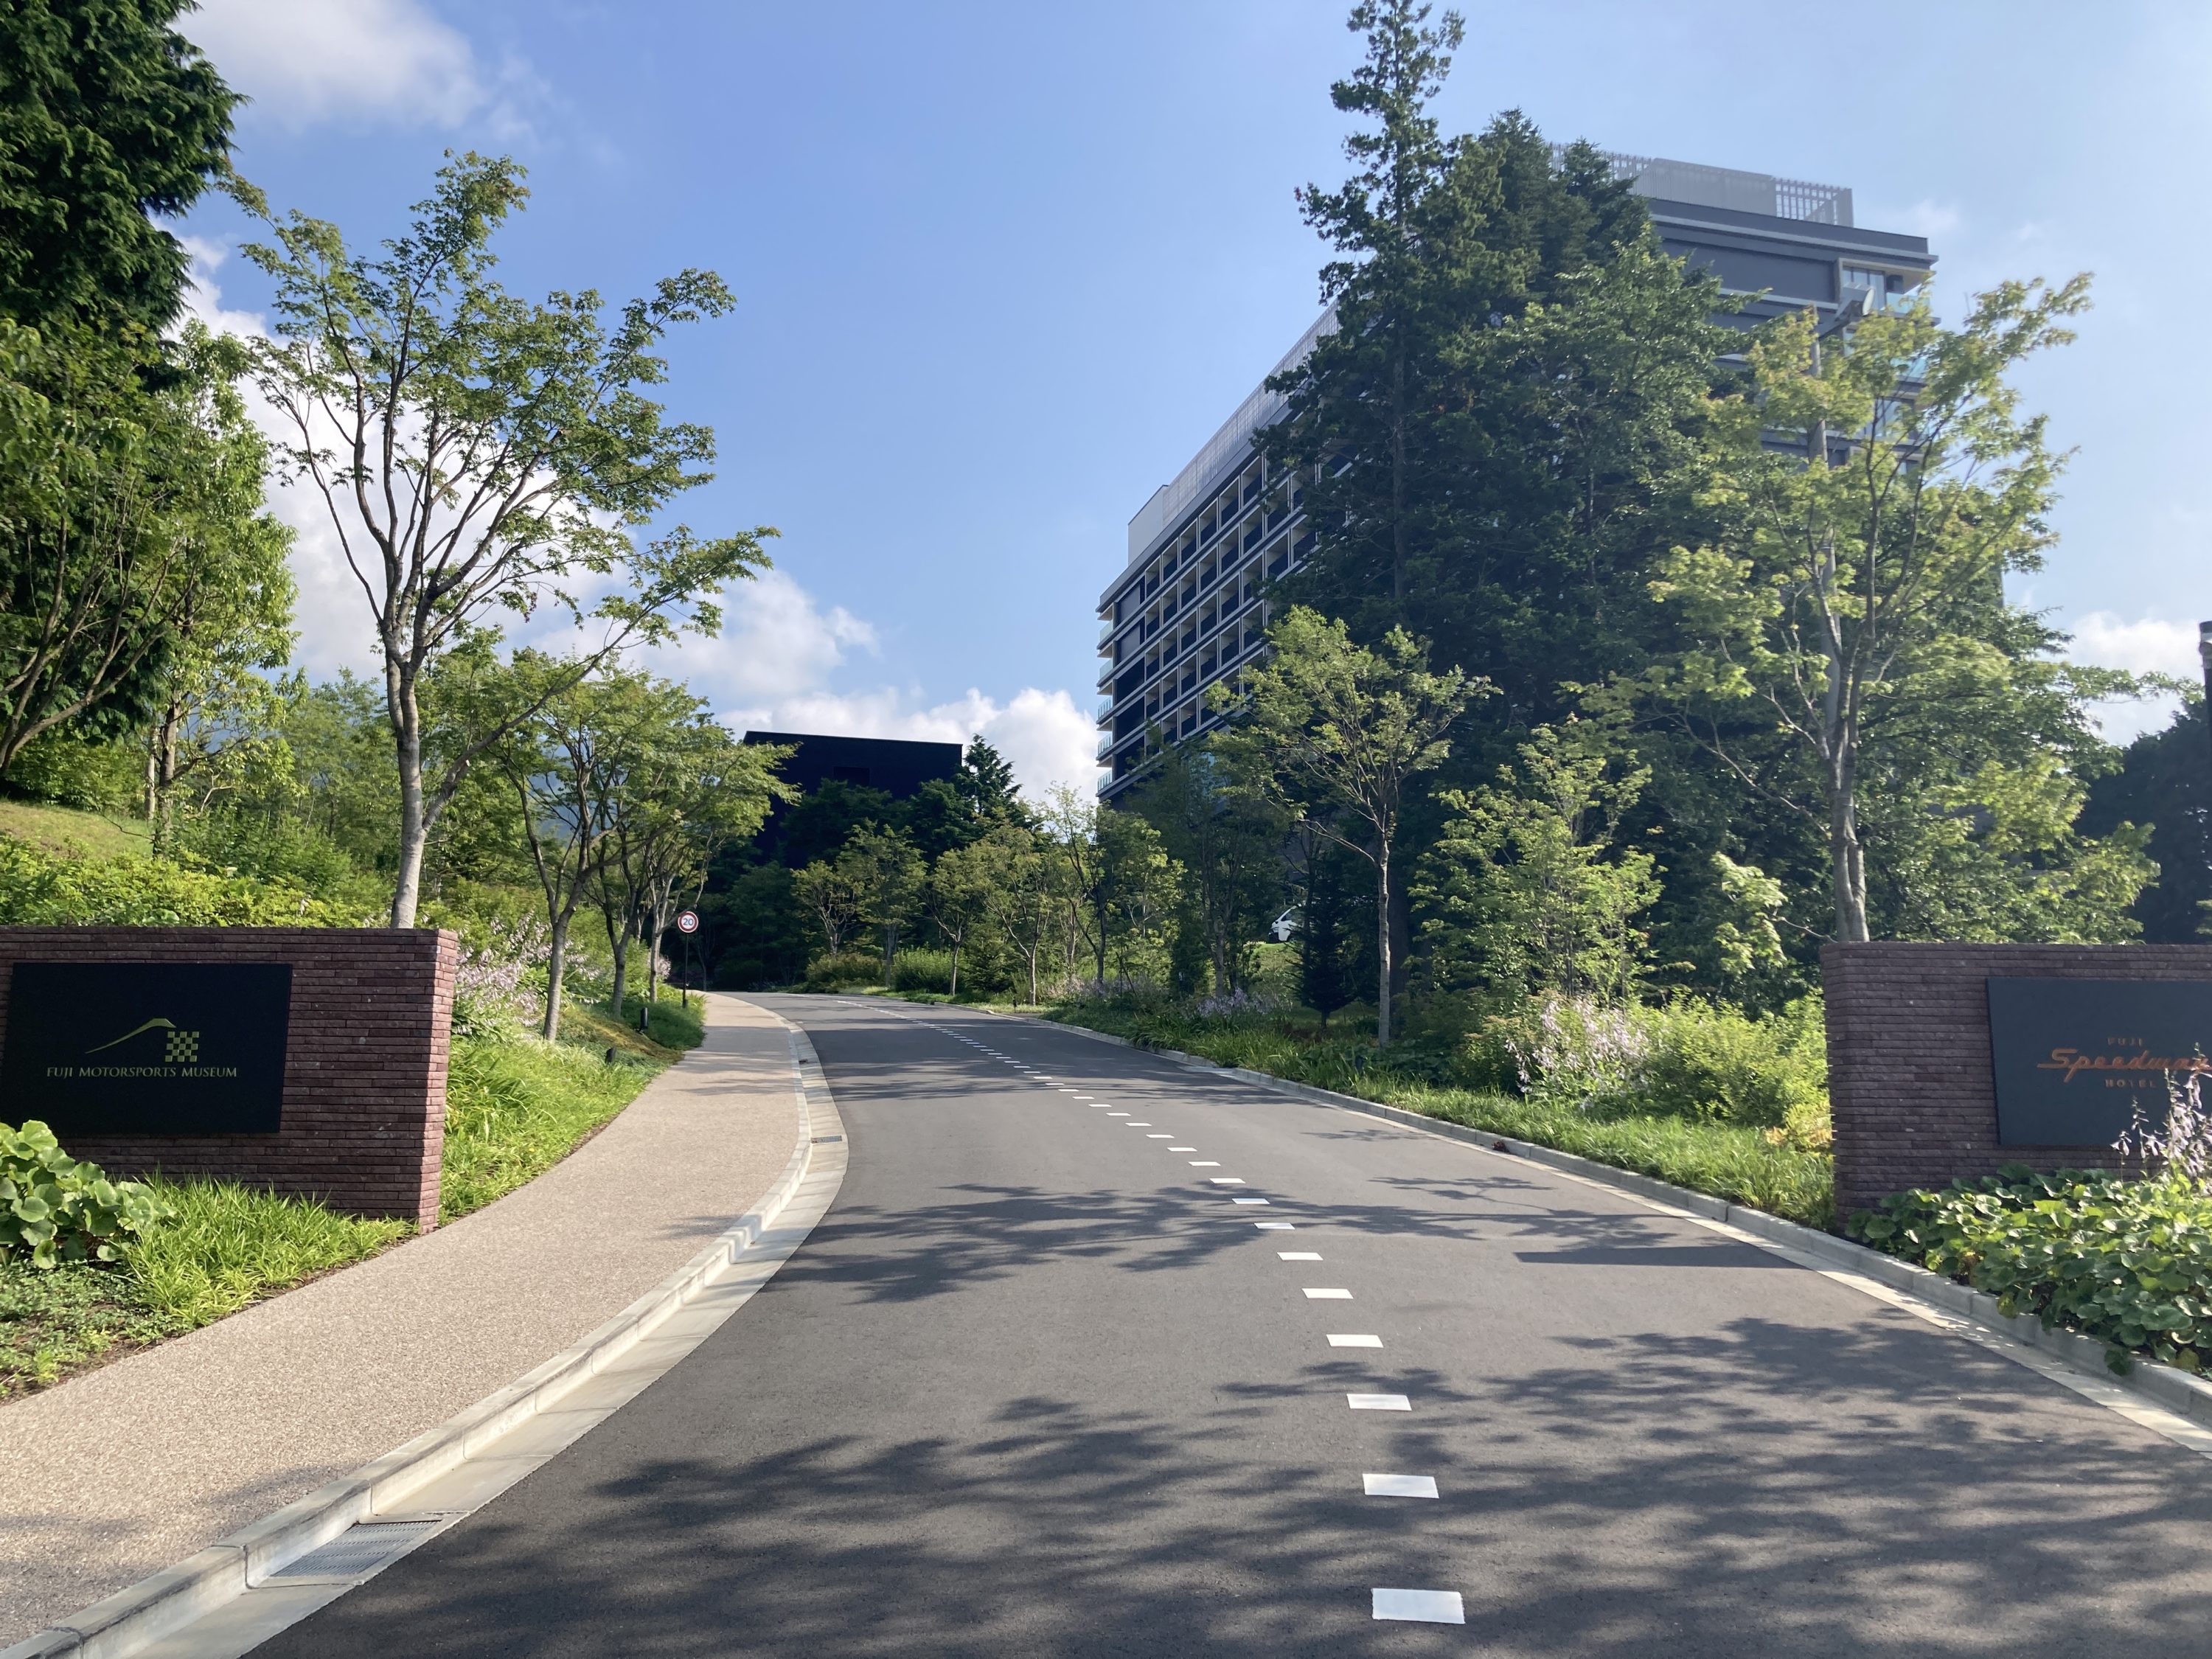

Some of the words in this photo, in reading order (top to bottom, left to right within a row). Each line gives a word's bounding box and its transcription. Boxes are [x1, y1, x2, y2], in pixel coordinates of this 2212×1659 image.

[683, 918, 694, 926] 20
[2107, 1037, 2144, 1046] FUJI
[46, 1067, 73, 1077] FUJI
[79, 1066, 176, 1078] MOTORSPORTS
[181, 1066, 237, 1078] MUSEUM
[2105, 1079, 2157, 1088] HOTEL
